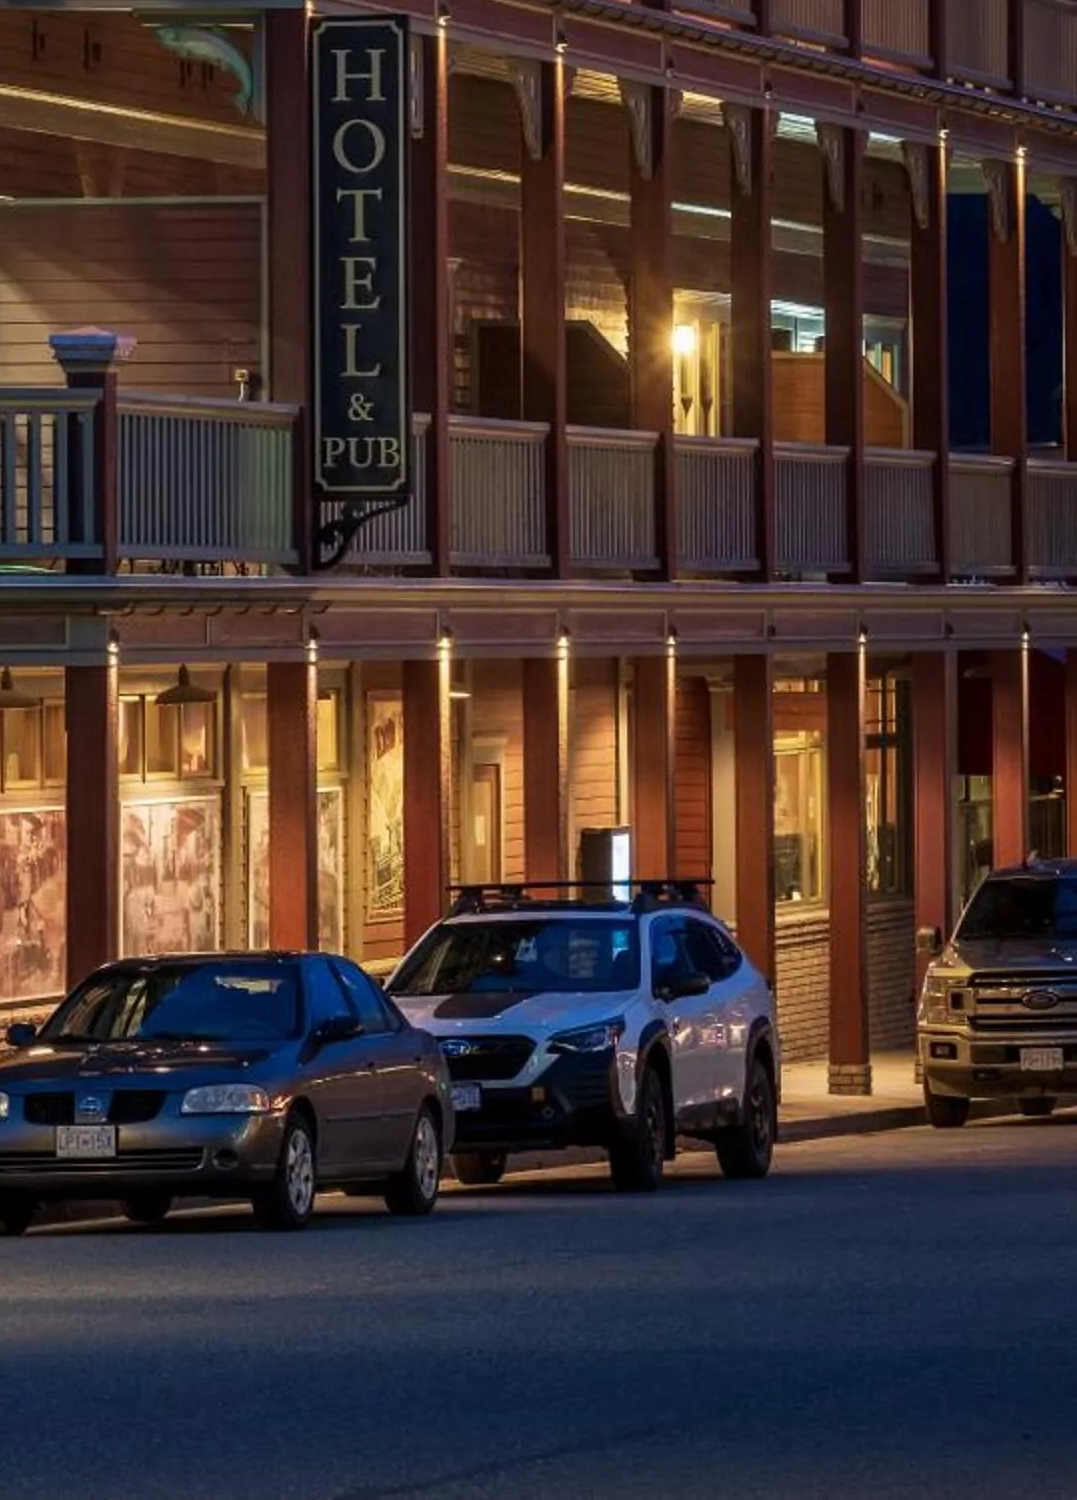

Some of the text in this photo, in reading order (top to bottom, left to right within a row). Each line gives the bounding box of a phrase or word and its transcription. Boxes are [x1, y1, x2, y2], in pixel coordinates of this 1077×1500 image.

[331, 49, 386, 377] HOTEL
[347, 393, 374, 421] &
[324, 437, 400, 468] PUB
